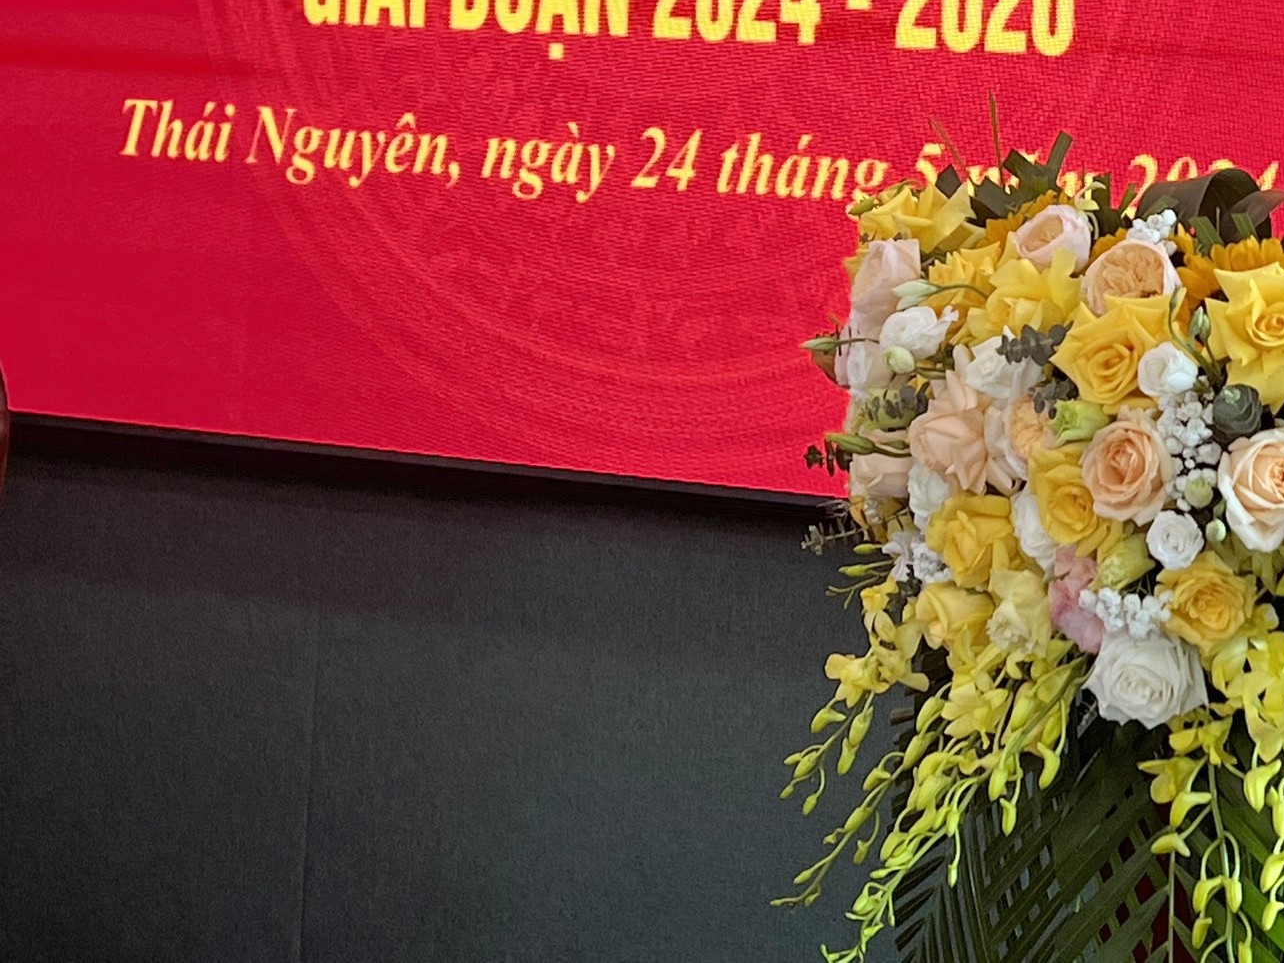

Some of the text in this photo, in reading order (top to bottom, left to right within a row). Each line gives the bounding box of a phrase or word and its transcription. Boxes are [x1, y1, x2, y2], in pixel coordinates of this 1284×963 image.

[120, 98, 236, 163] Thái
[246, 105, 461, 189] Nguyên,
[480, 121, 616, 204] ngày
[630, 125, 703, 193] 24
[716, 131, 889, 221] tháng
